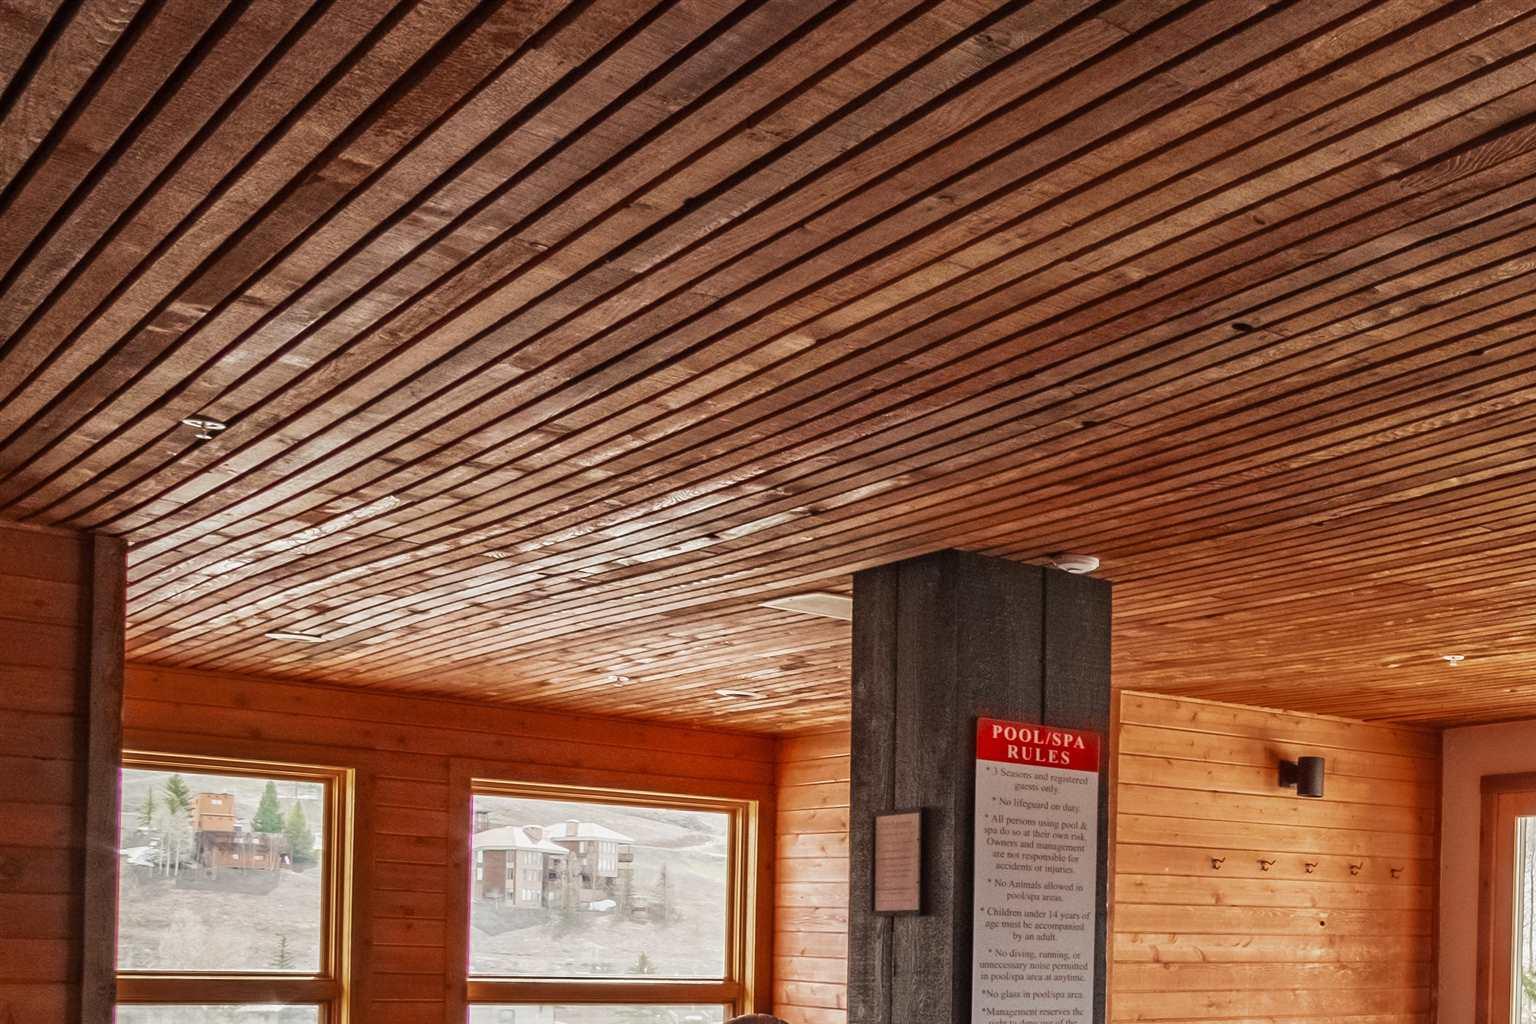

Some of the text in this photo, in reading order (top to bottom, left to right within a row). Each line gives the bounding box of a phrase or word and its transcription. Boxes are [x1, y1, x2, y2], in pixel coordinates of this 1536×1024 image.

[992, 724, 1085, 749] POOL/SPA
[1007, 744, 1070, 764] RULES
[1001, 768, 1032, 780] Seasons
[1034, 772, 1048, 780] and
[1050, 775, 1088, 785] registered
[1014, 783, 1039, 792] guests
[999, 798, 1011, 806] No
[1013, 798, 1049, 810] lifeguard
[991, 815, 1004, 823] All
[1006, 816, 1036, 827] persons
[1038, 819, 1060, 830] using
[1061, 821, 1078, 831] pool
[984, 827, 998, 836] spa
[1000, 826, 1010, 835] do
[1023, 829, 1031, 837] at
[1032, 828, 1050, 839] their
[985, 837, 1085, 852] Owners and management
[992, 850, 1080, 862] are not responsible for
[995, 862, 1032, 872] accidents
[994, 879, 1006, 887] No
[1009, 880, 1041, 889] Animals
[1043, 882, 1074, 891] allowed
[987, 907, 1091, 920] Children under 14 years of
[985, 920, 1085, 932] age must be accompanied
[1012, 932, 1022, 941] by
[995, 949, 1008, 958] No
[979, 961, 1088, 971] unnecessary noise permitted
[990, 971, 1024, 982] pool/spa
[1001, 989, 1020, 1000] glass
[1072, 1007, 1084, 1016] the
